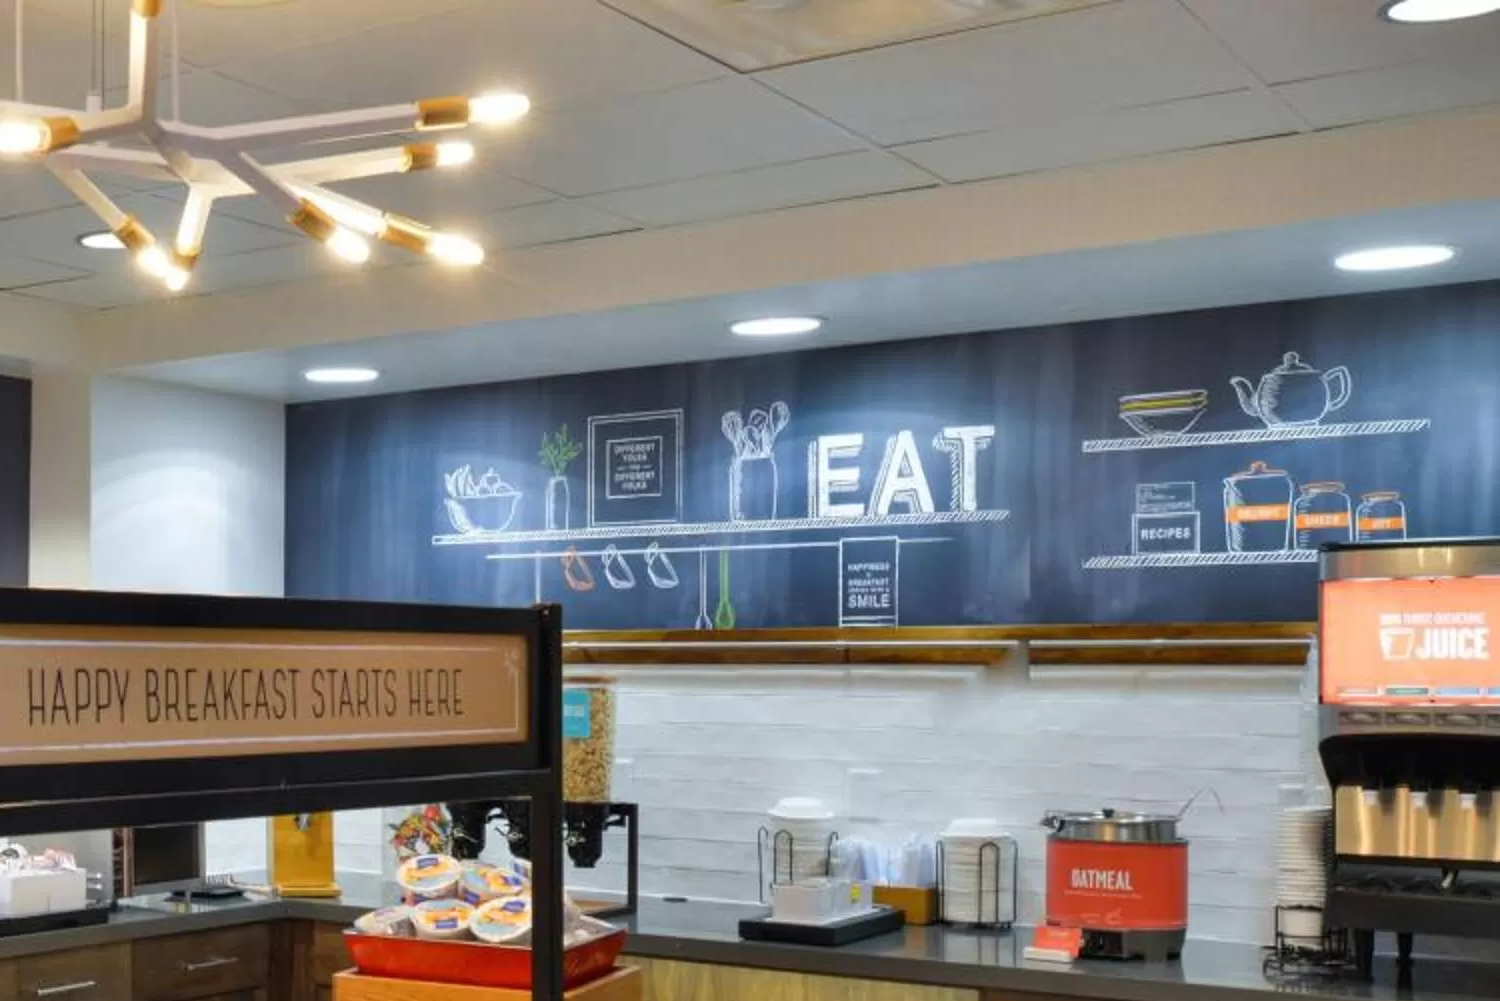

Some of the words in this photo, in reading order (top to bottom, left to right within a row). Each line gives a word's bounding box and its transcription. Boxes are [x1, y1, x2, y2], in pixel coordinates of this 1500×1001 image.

[808, 424, 996, 517] EAT
[1141, 527, 1191, 541] RECIPES
[848, 593, 891, 608] SMILE
[1415, 626, 1490, 661] JUICE
[27, 668, 130, 726] HAPPY
[145, 667, 300, 723] BREAKFAST
[311, 668, 397, 719] STARTS
[407, 668, 464, 717] HERE
[1071, 868, 1133, 891] OATMEAL
